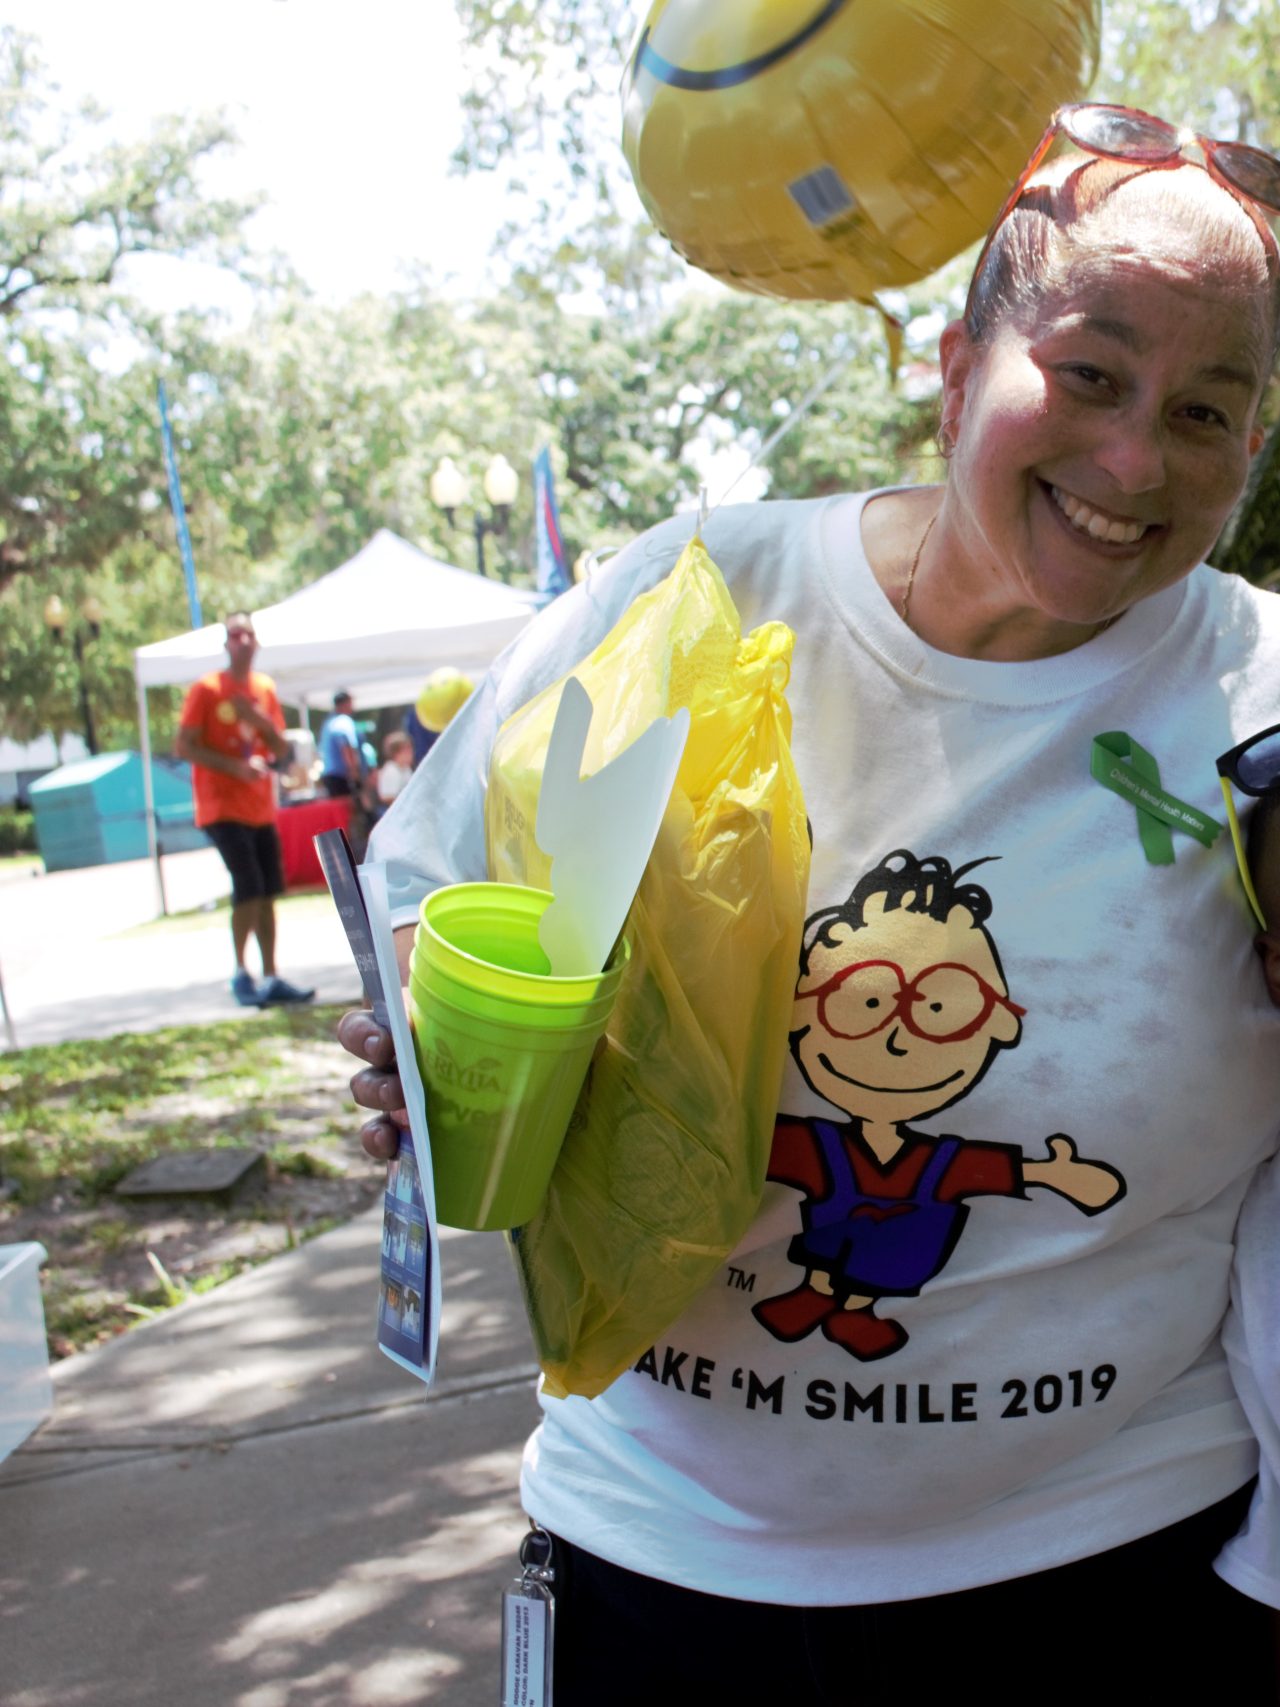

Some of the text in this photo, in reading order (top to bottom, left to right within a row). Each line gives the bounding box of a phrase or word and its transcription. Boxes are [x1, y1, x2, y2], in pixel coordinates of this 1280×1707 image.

[1161, 801, 1181, 818] Health
[727, 1266, 757, 1293] TM
[628, 1344, 716, 1401] AKE
[805, 1379, 978, 1424] SMILE
[1000, 1363, 1118, 1419] 2019
